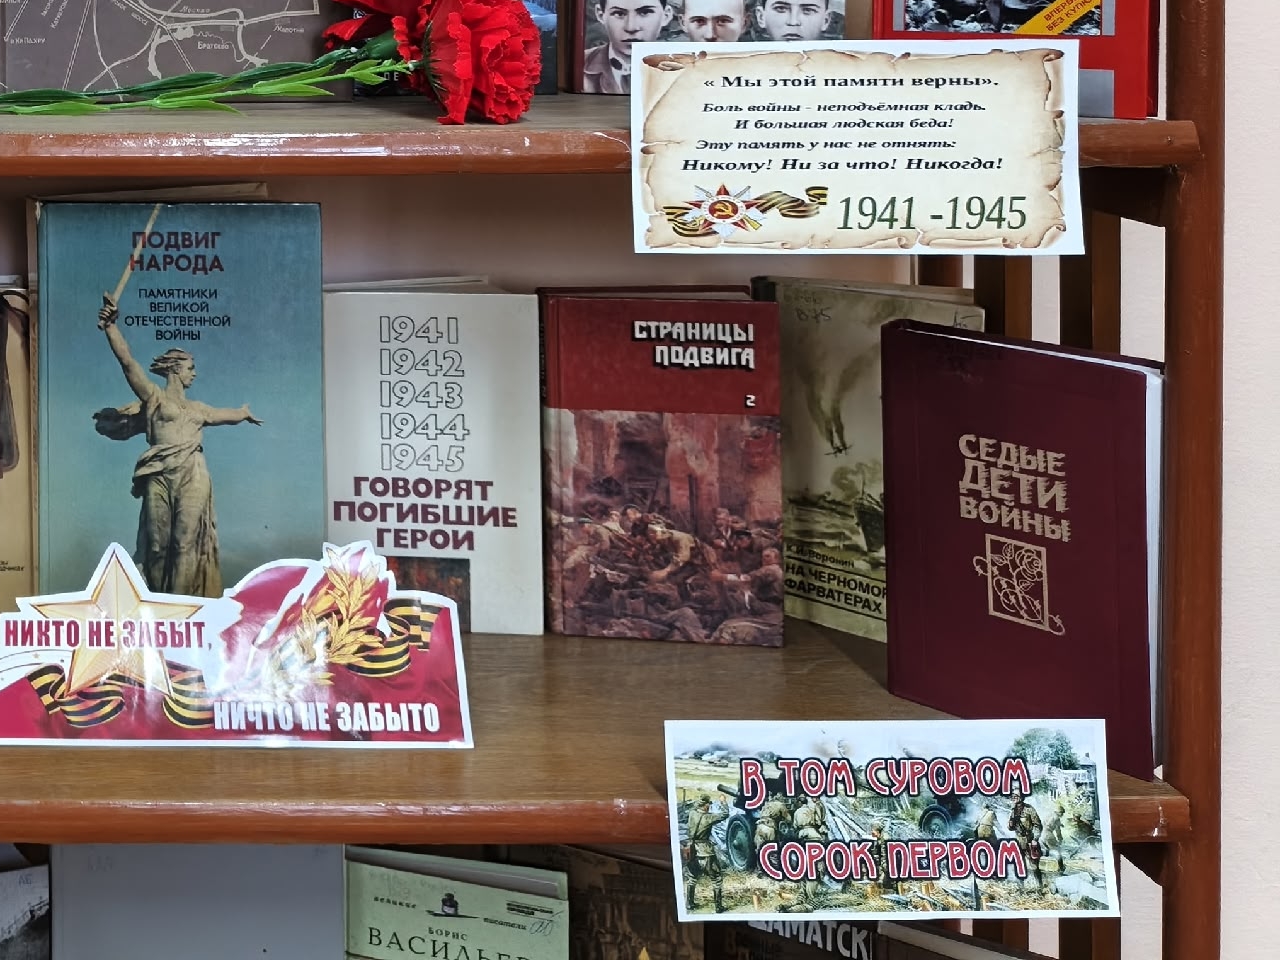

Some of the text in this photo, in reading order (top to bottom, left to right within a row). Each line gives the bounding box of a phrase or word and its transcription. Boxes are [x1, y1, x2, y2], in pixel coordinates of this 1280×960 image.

[769, 75, 999, 90] этой памяти верны».
[702, 101, 987, 113] Боль войны неподъёмная кладь.
[754, 118, 955, 129] большая людская беда!
[695, 140, 956, 151] Эту память нас отнять:
[681, 157, 1004, 172] Никому! что! Никогда!
[132, 231, 221, 251] ПОДВИГ
[130, 254, 224, 275] НАРОДА
[139, 289, 217, 299] ПАМЯТНИКИ
[150, 301, 209, 312] ВЕЛИКОЙ
[125, 315, 231, 327] ОТЕЧЕСТВЕННОЙ
[379, 315, 459, 344] 1941
[633, 320, 754, 343] СТРАНИЦЫ
[156, 329, 200, 340] ВОЙНЫ
[379, 348, 465, 377] 1942
[654, 345, 755, 369] ПОДВИГА
[379, 380, 464, 409] 1943
[380, 412, 470, 441] 1944
[380, 443, 465, 472] 1945
[959, 434, 1066, 477] СЕДЫЕ
[353, 475, 494, 503] ГОВОРЯТ
[959, 458, 1070, 513] ДЕТИ
[333, 500, 518, 529] ПОГИБШИЕ
[960, 495, 1071, 542] ВОЙНЫ
[376, 528, 475, 552] ГЕРОИ
[785, 578, 882, 615] ФАРВАТЕРАХ
[4, 619, 78, 648] НИКТО
[214, 700, 439, 733] НИЧТО ЗАБЫТО
[778, 758, 1031, 797] ТОМ СУРОВОМ
[759, 840, 1027, 880] СОРОК ПЕРВОМ
[428, 926, 468, 941] БОРИС
